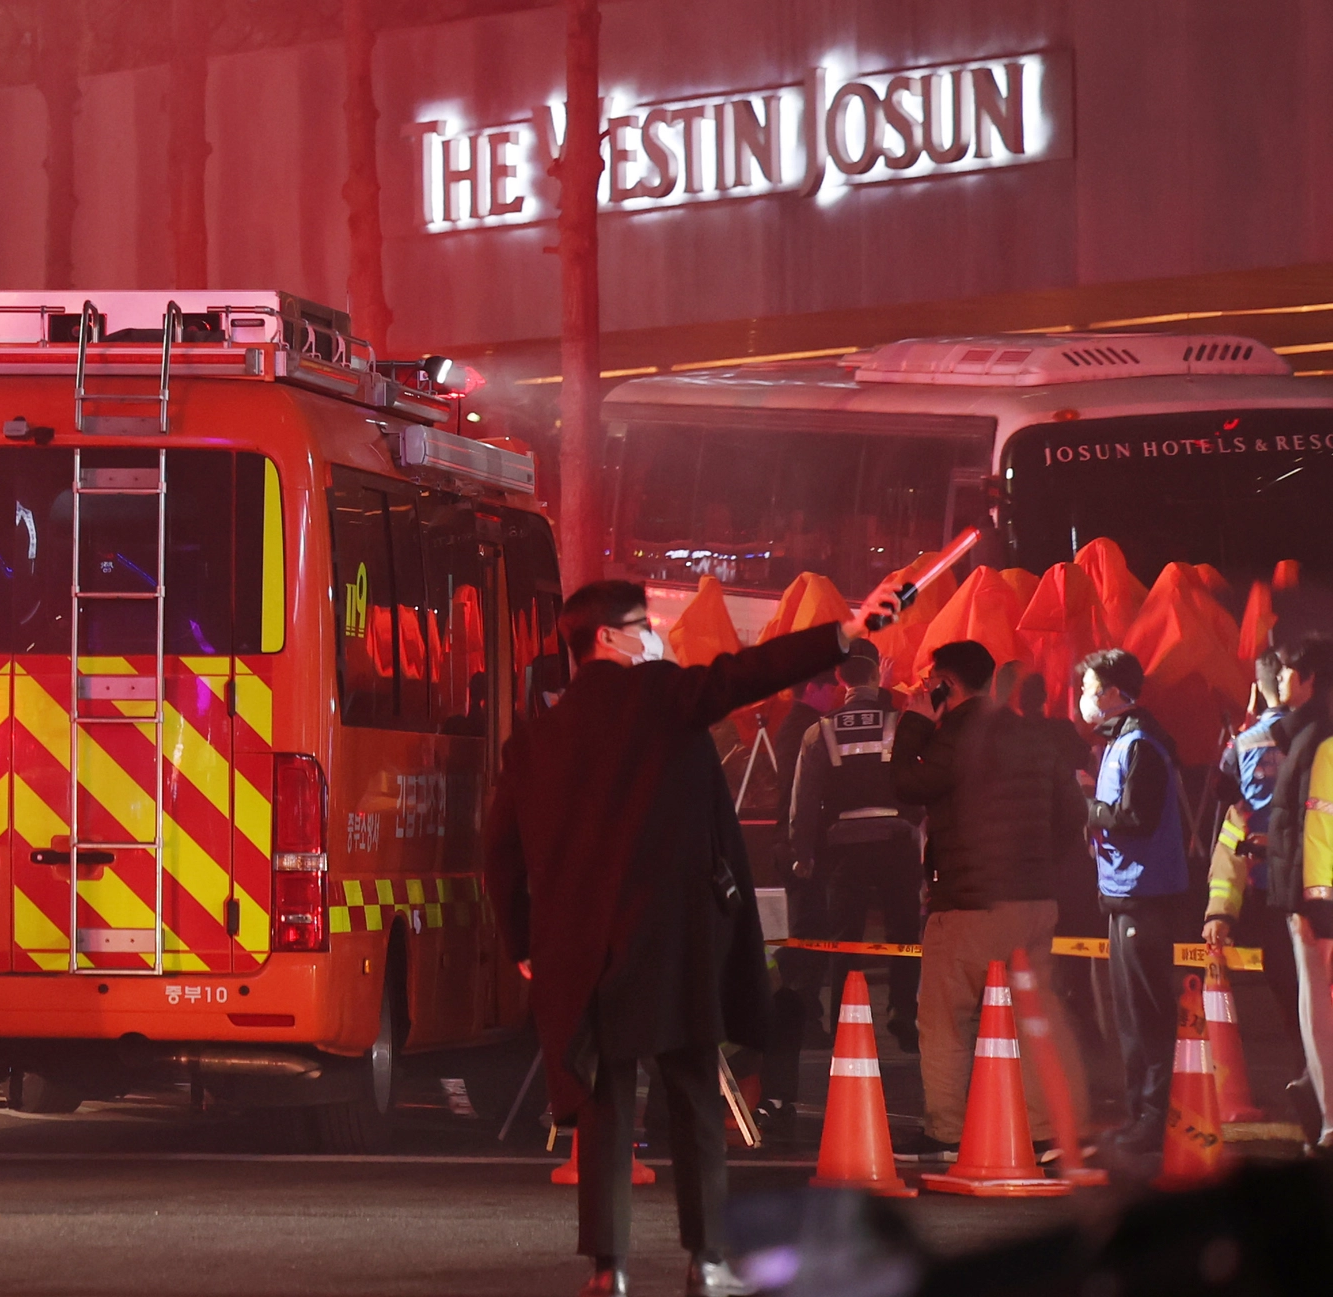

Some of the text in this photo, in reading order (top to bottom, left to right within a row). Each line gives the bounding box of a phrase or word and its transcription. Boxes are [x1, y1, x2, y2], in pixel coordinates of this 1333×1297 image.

[401, 118, 524, 225] THE
[799, 59, 1025, 199] JOSUN
[1043, 442, 1130, 467] JOSUN
[1143, 436, 1248, 458] HOTELS
[1255, 438, 1269, 453] &
[345, 561, 368, 639] 119
[164, 984, 229, 1005] 중부10
